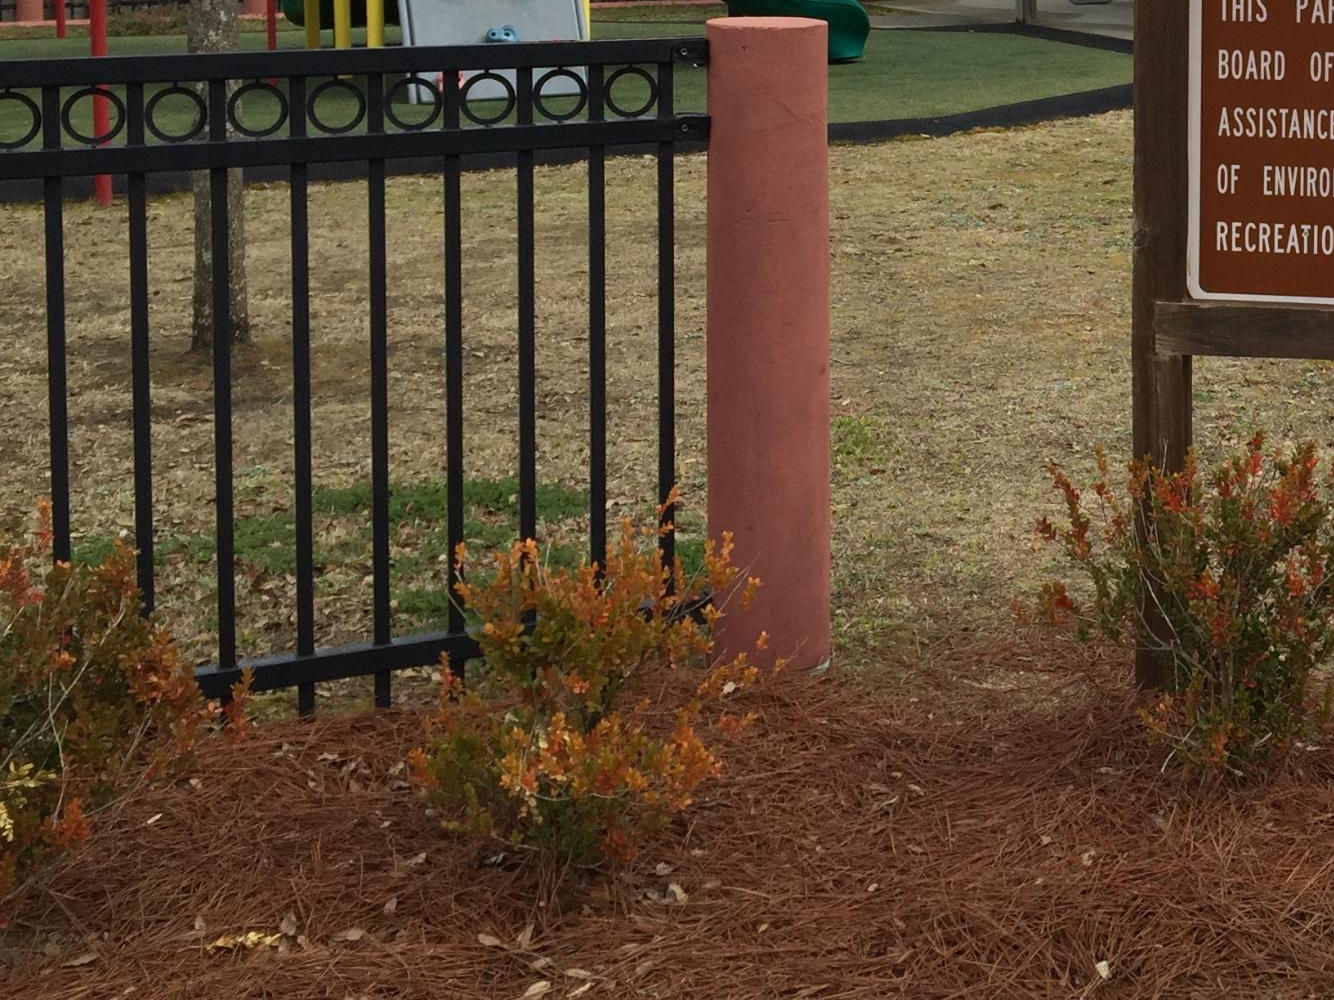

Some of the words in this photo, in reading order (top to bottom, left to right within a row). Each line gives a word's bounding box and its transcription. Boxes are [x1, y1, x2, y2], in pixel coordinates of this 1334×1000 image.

[1218, 49, 1286, 81] BOARD
[1310, 51, 1334, 82] OF
[1217, 163, 1241, 194] OF
